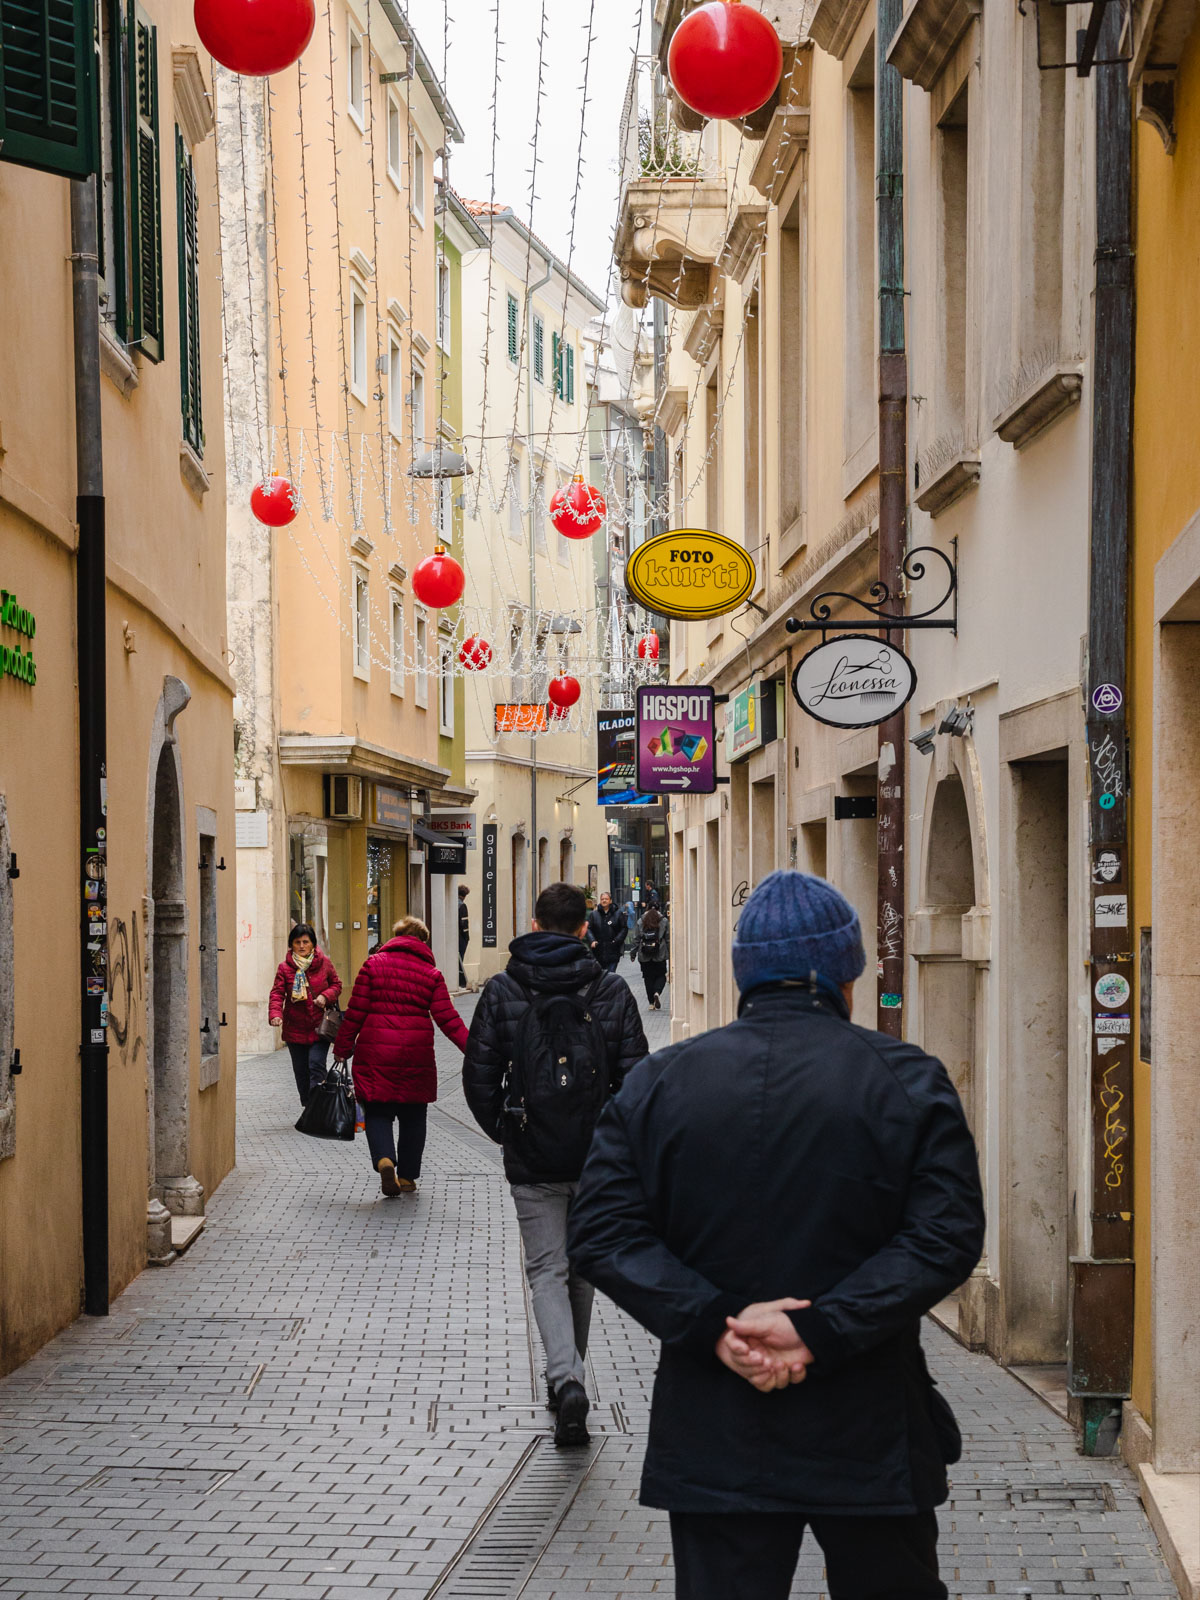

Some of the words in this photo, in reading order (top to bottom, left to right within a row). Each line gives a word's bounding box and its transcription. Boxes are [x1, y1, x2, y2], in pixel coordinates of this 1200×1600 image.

[669, 549, 714, 564] FOTO
[644, 558, 741, 590] kurti
[809, 655, 903, 707] Leonessa
[642, 695, 711, 721] HGSPOT
[652, 764, 700, 774] www.hgshop.hr
[431, 821, 448, 830] BKS
[451, 821, 472, 830] Bank
[486, 834, 494, 930] galerija
